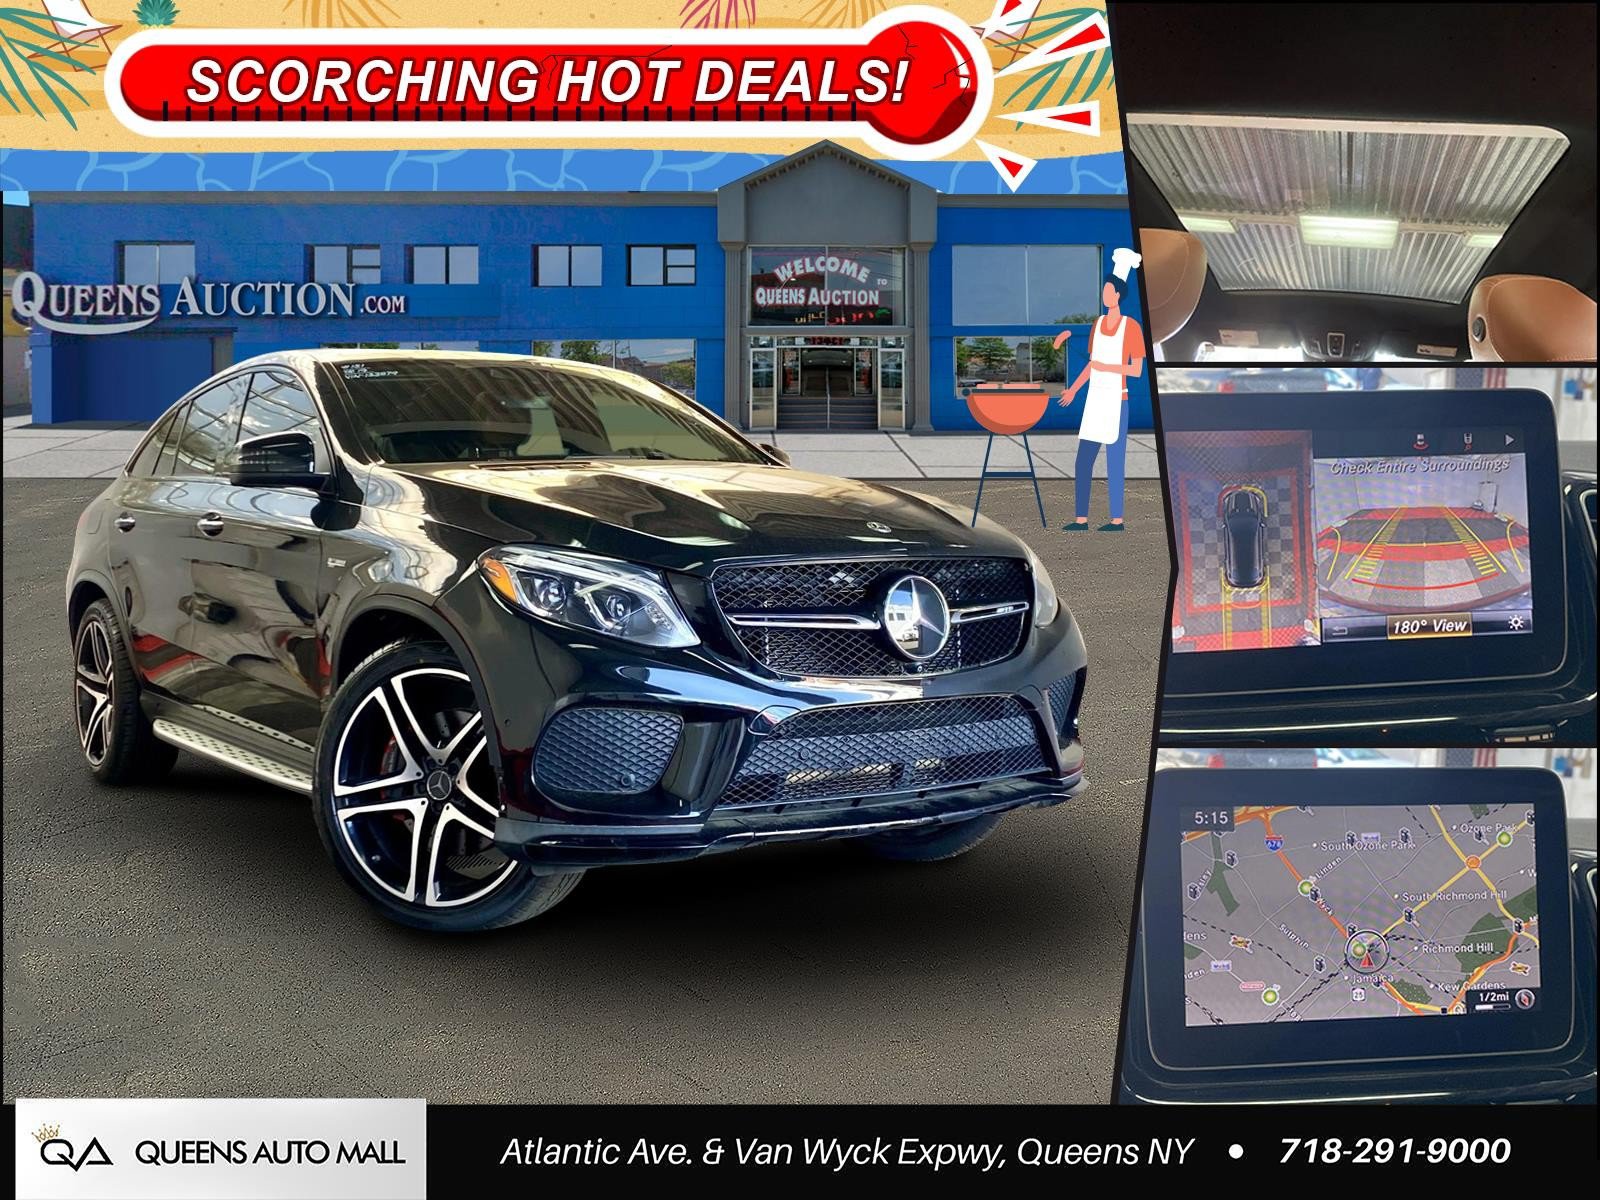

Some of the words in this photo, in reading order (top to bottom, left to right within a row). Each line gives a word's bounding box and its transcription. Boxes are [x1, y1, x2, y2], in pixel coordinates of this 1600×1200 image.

[774, 256, 871, 283] WELCOME
[877, 278, 887, 286] TO
[755, 287, 805, 306] QUEENS
[808, 287, 879, 306] AUCTION
[12, 271, 161, 335] QUEENS
[1330, 461, 1373, 475] Check
[1376, 460, 1417, 474] Entire
[1421, 457, 1512, 473] Surroundings
[1394, 619, 1428, 634] 180°
[1433, 619, 1467, 633] View
[1194, 811, 1229, 824] 5:15
[1460, 824, 1492, 833] Ozone
[1495, 823, 1519, 833] Park
[1320, 841, 1351, 851] South
[1355, 841, 1387, 850] Ozone
[1391, 840, 1414, 849] Park
[1315, 856, 1342, 879] Linden
[1403, 892, 1433, 902] South
[1436, 891, 1487, 901] Richmond
[1491, 891, 1507, 900] Hill
[1279, 923, 1309, 949] Sutphin
[1422, 943, 1473, 953] Richmond
[1476, 943, 1493, 952] Hill
[1353, 974, 1394, 984] Jamaica
[1438, 983, 1459, 991] Kew
[1463, 982, 1506, 991] Gardens
[1480, 992, 1509, 1002] 1/2mi
